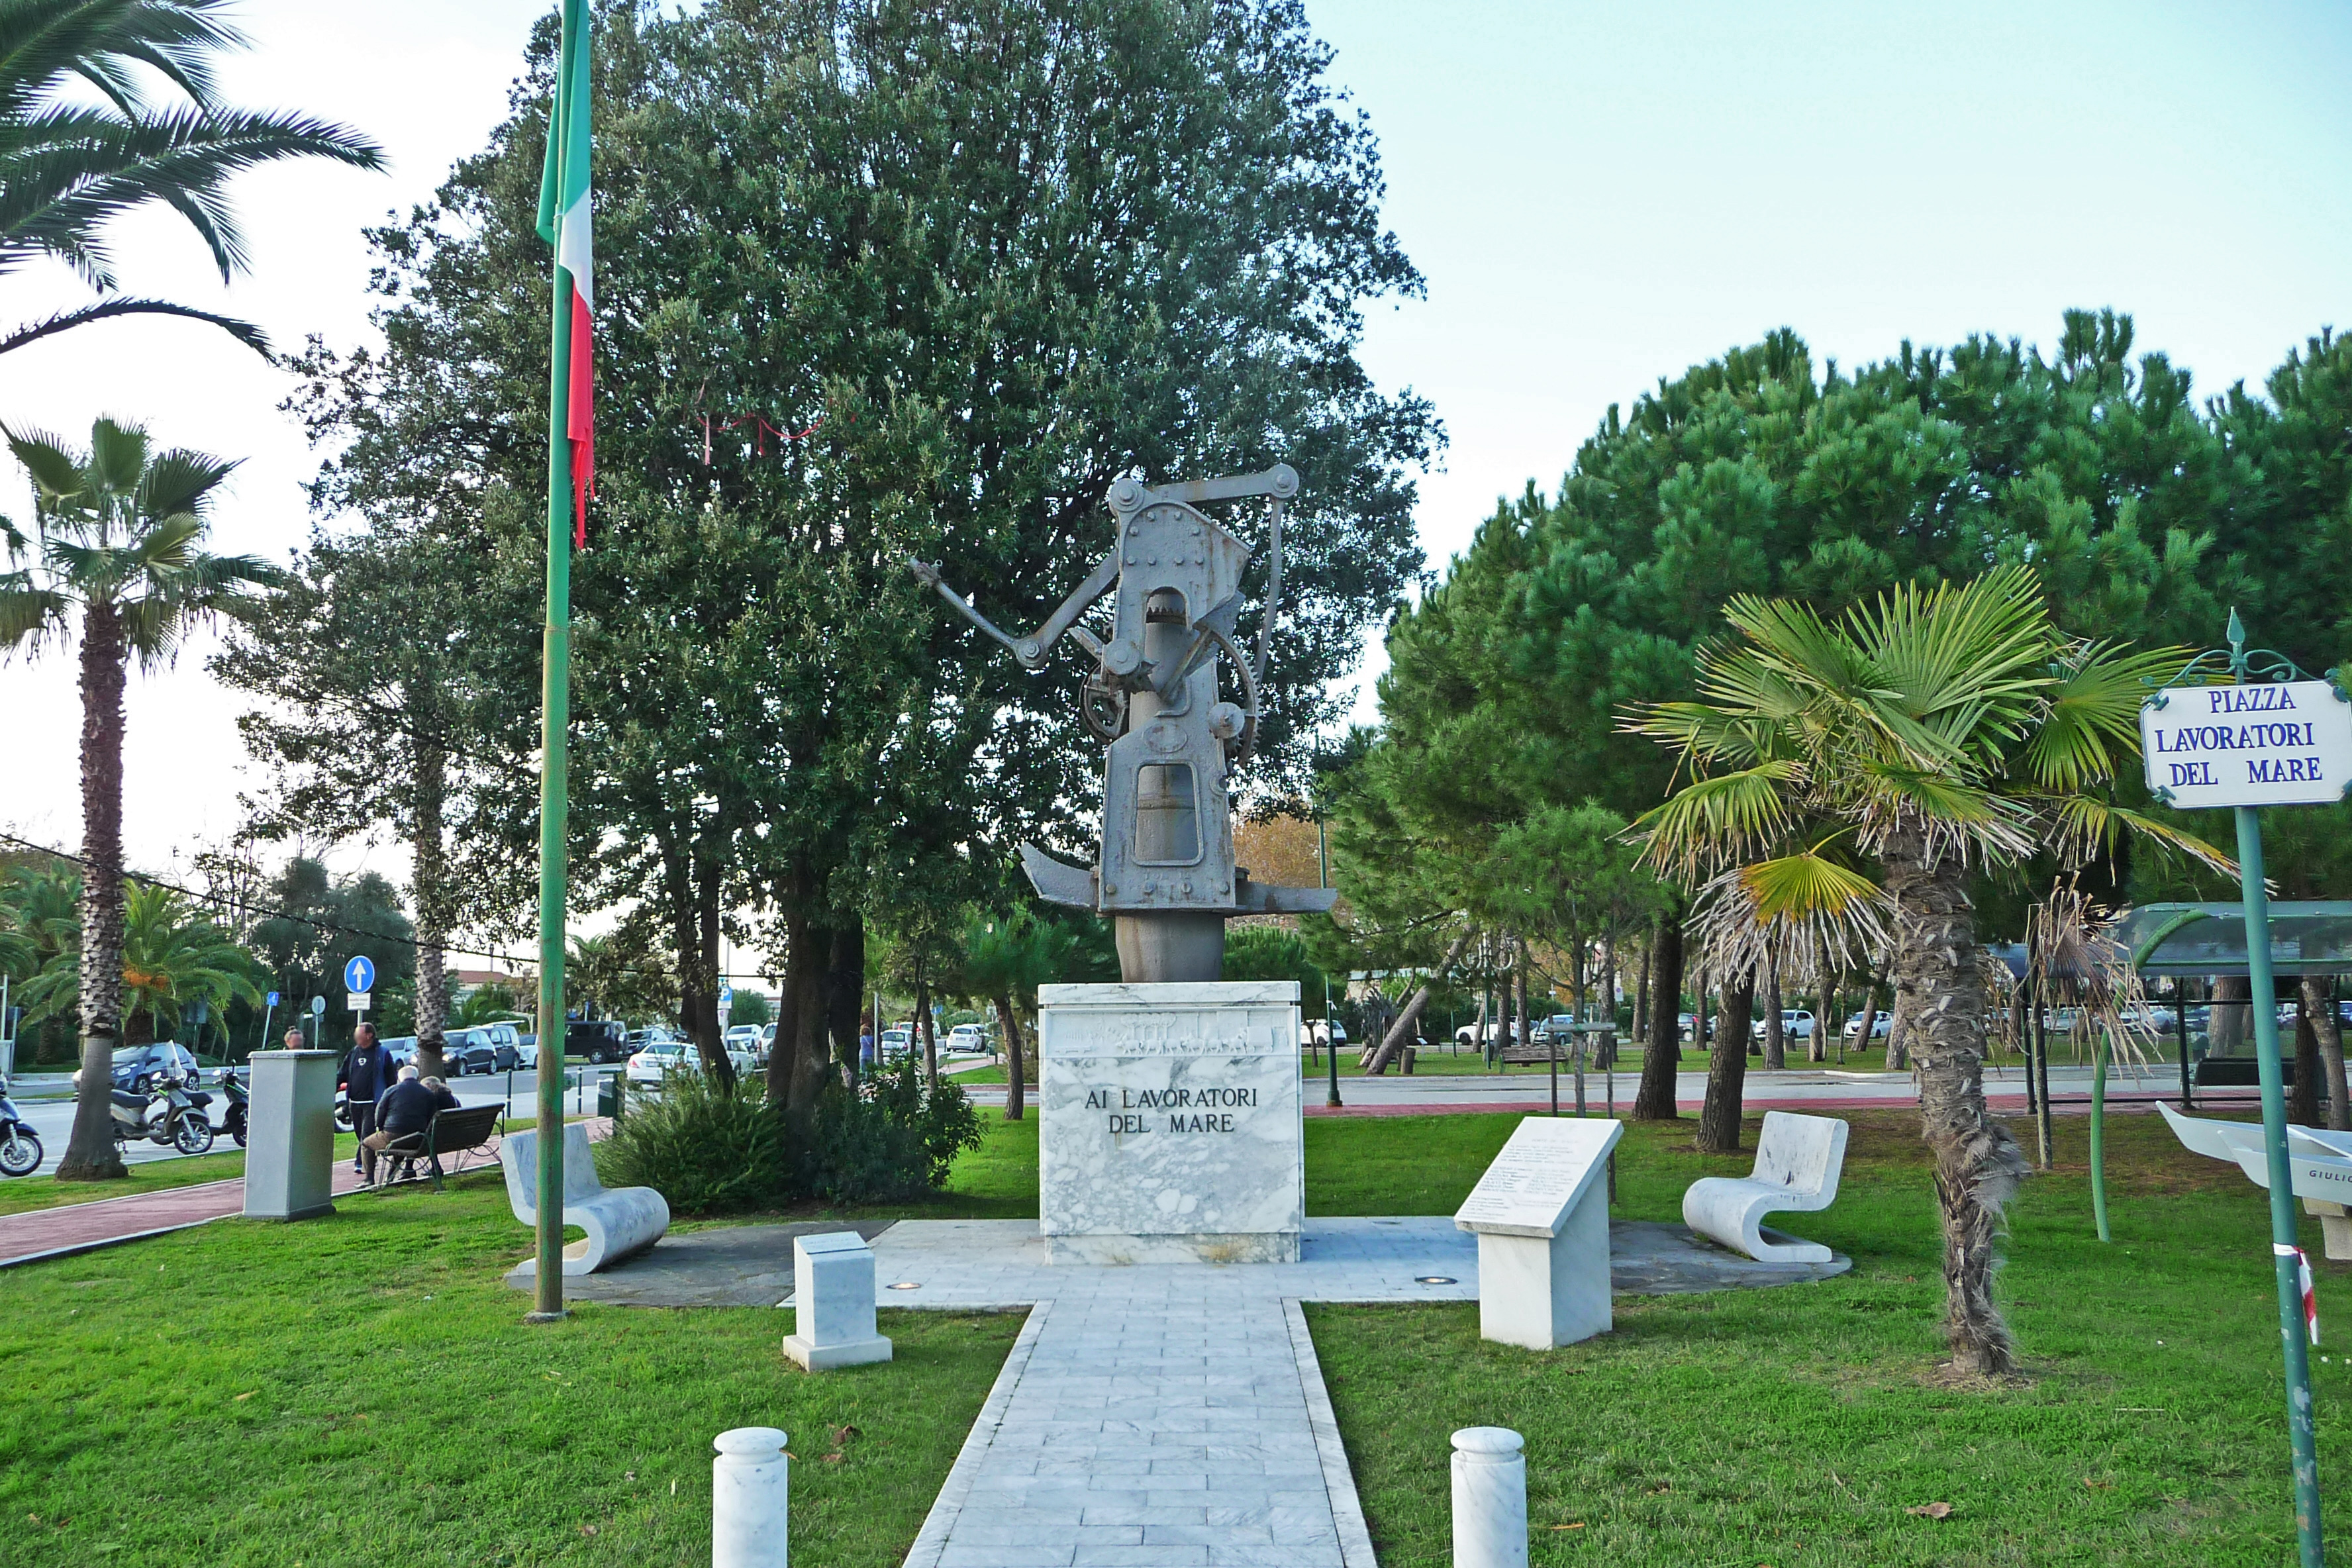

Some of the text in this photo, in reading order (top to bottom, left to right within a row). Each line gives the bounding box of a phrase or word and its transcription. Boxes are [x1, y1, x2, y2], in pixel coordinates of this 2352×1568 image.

[2208, 687, 2296, 713] PIAZZA
[2155, 722, 2316, 752] LAVORATORI
[2169, 757, 2323, 787] DEL MARE
[1085, 1088, 1257, 1108] AI LAVORATORI
[1108, 1114, 1235, 1134] DEL MARE
